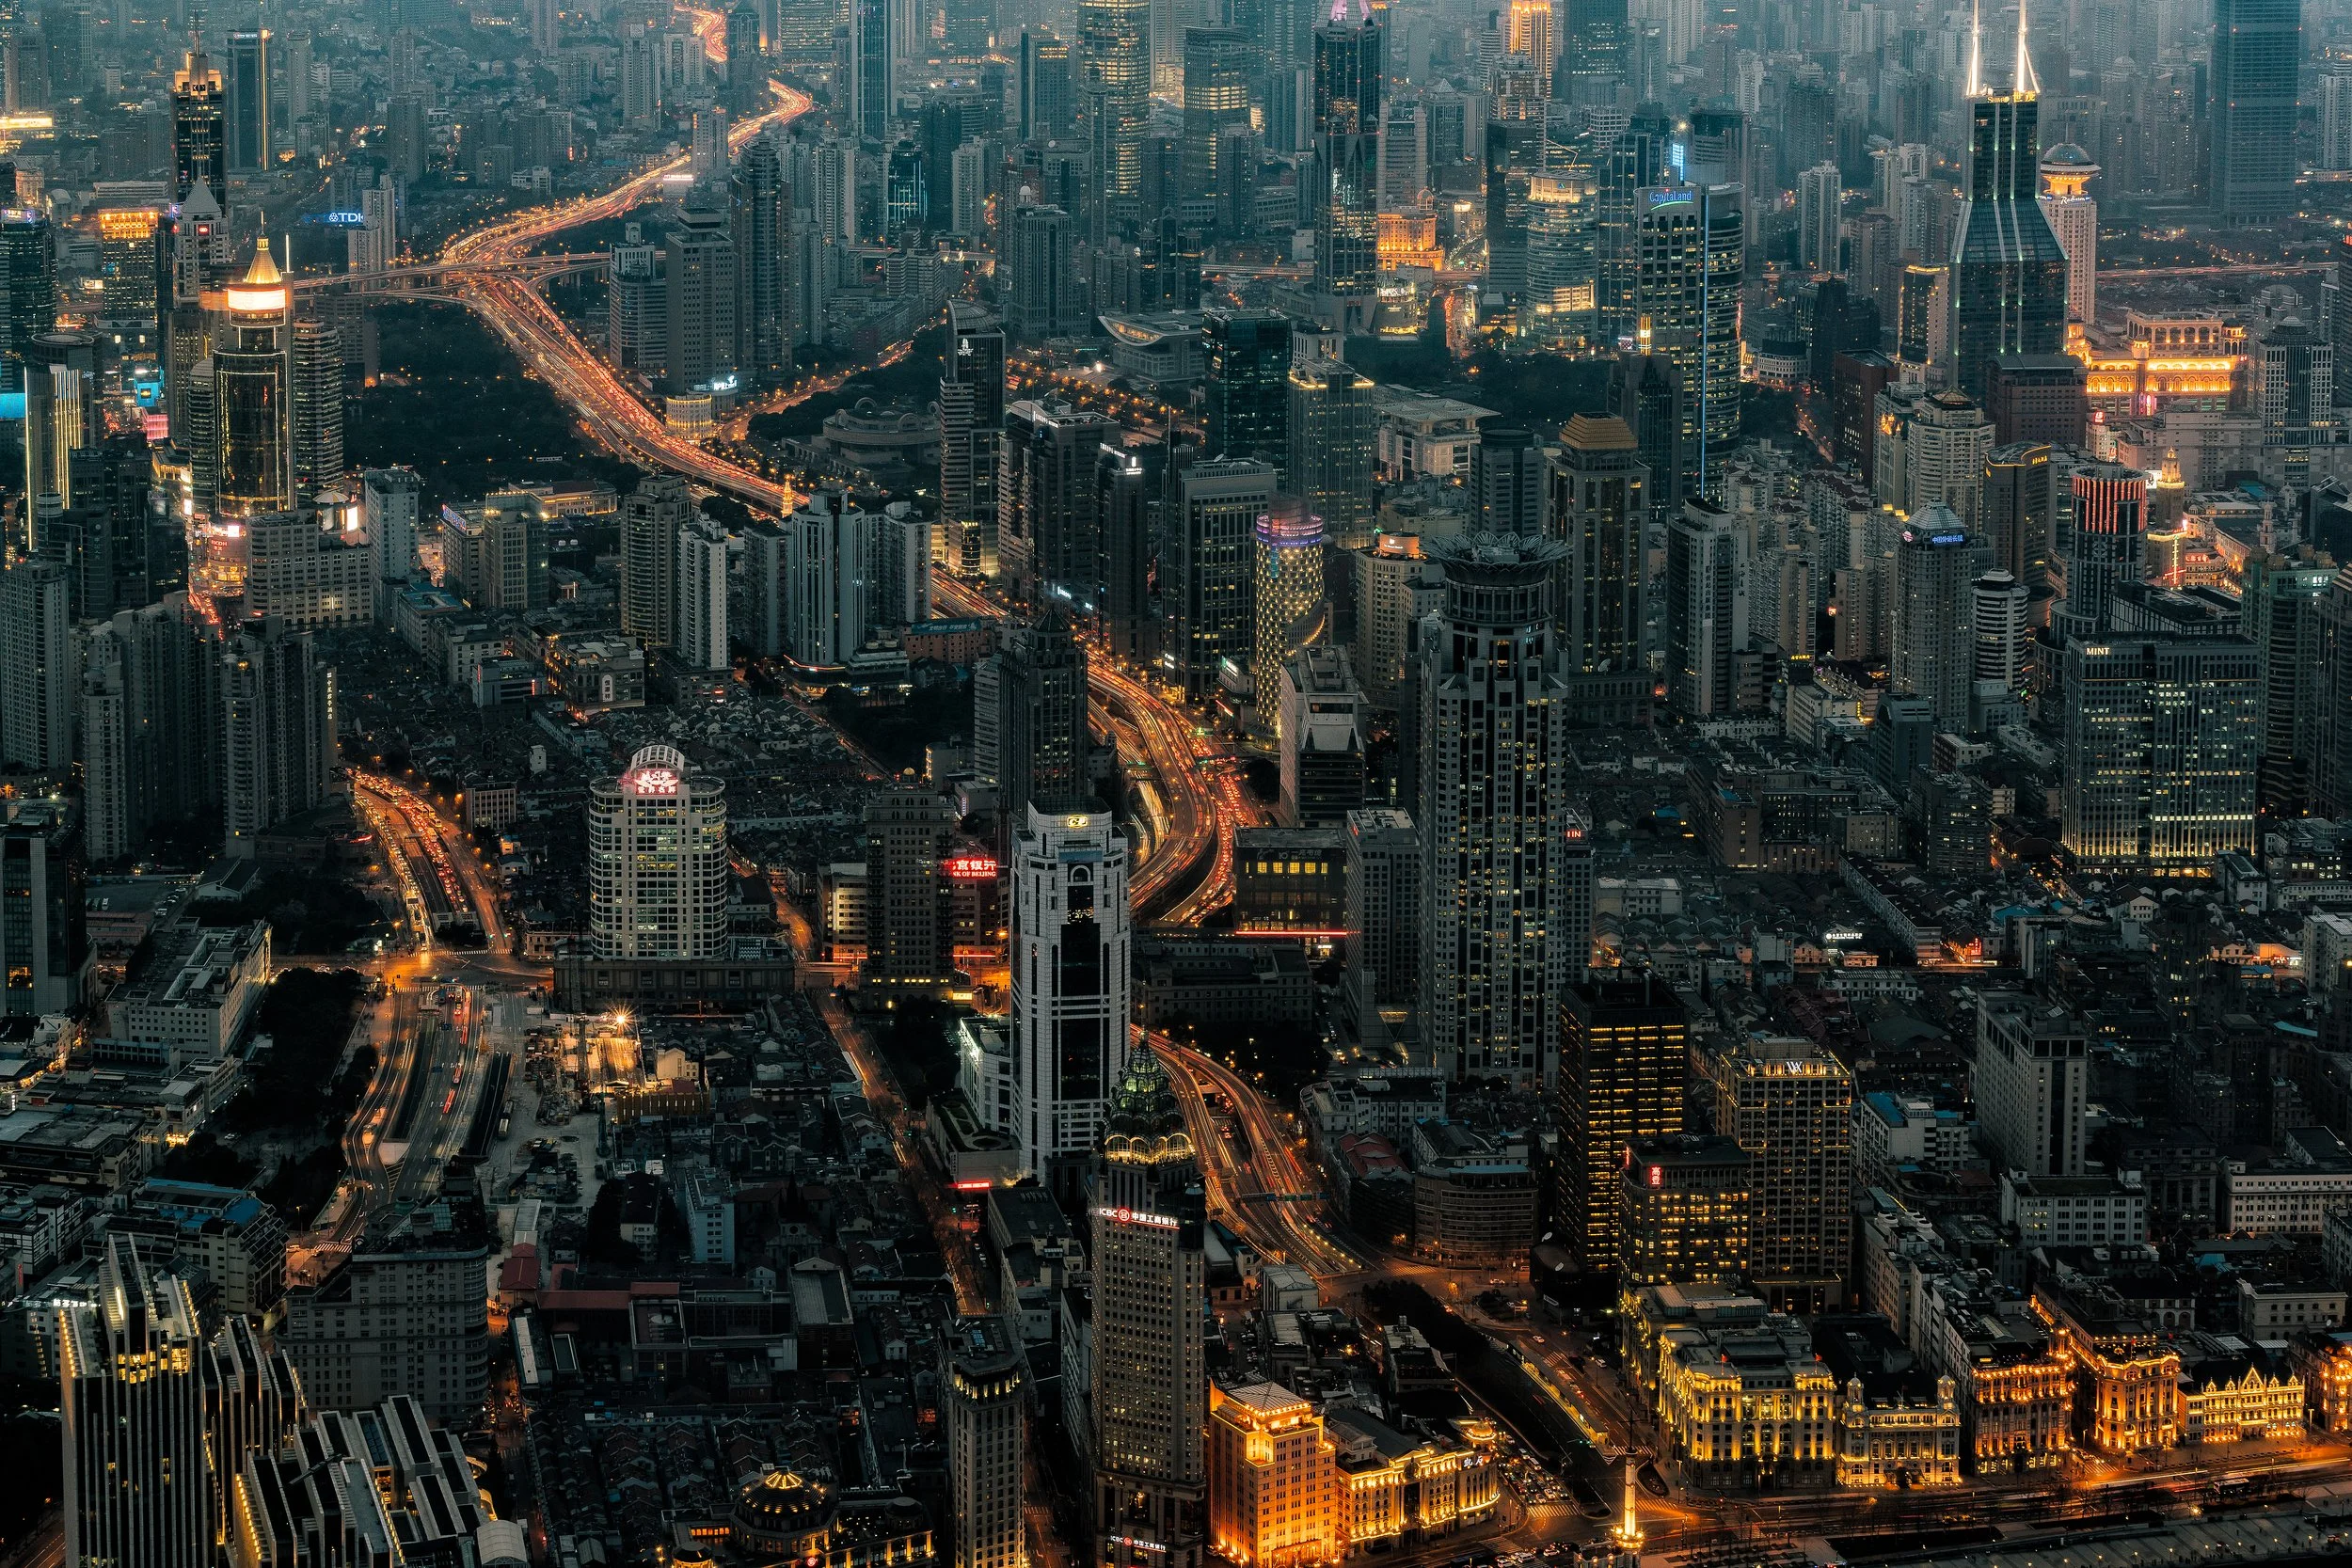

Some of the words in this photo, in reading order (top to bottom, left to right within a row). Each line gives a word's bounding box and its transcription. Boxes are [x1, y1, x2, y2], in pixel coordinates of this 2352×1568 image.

[2012, 90, 2036, 103] 世茂
[1649, 190, 1692, 203] CapitaLand
[2060, 195, 2085, 205] Radisson
[2086, 647, 2109, 656] MINT
[952, 860, 996, 871] 京银行
[1651, 1167, 1661, 1185] 高登
[1099, 1208, 1118, 1218] ICBC
[1132, 1212, 1178, 1227] 中国工商银行
[1110, 1535, 1123, 1544] ICBC
[1133, 1540, 1166, 1551] 中国工商银行
